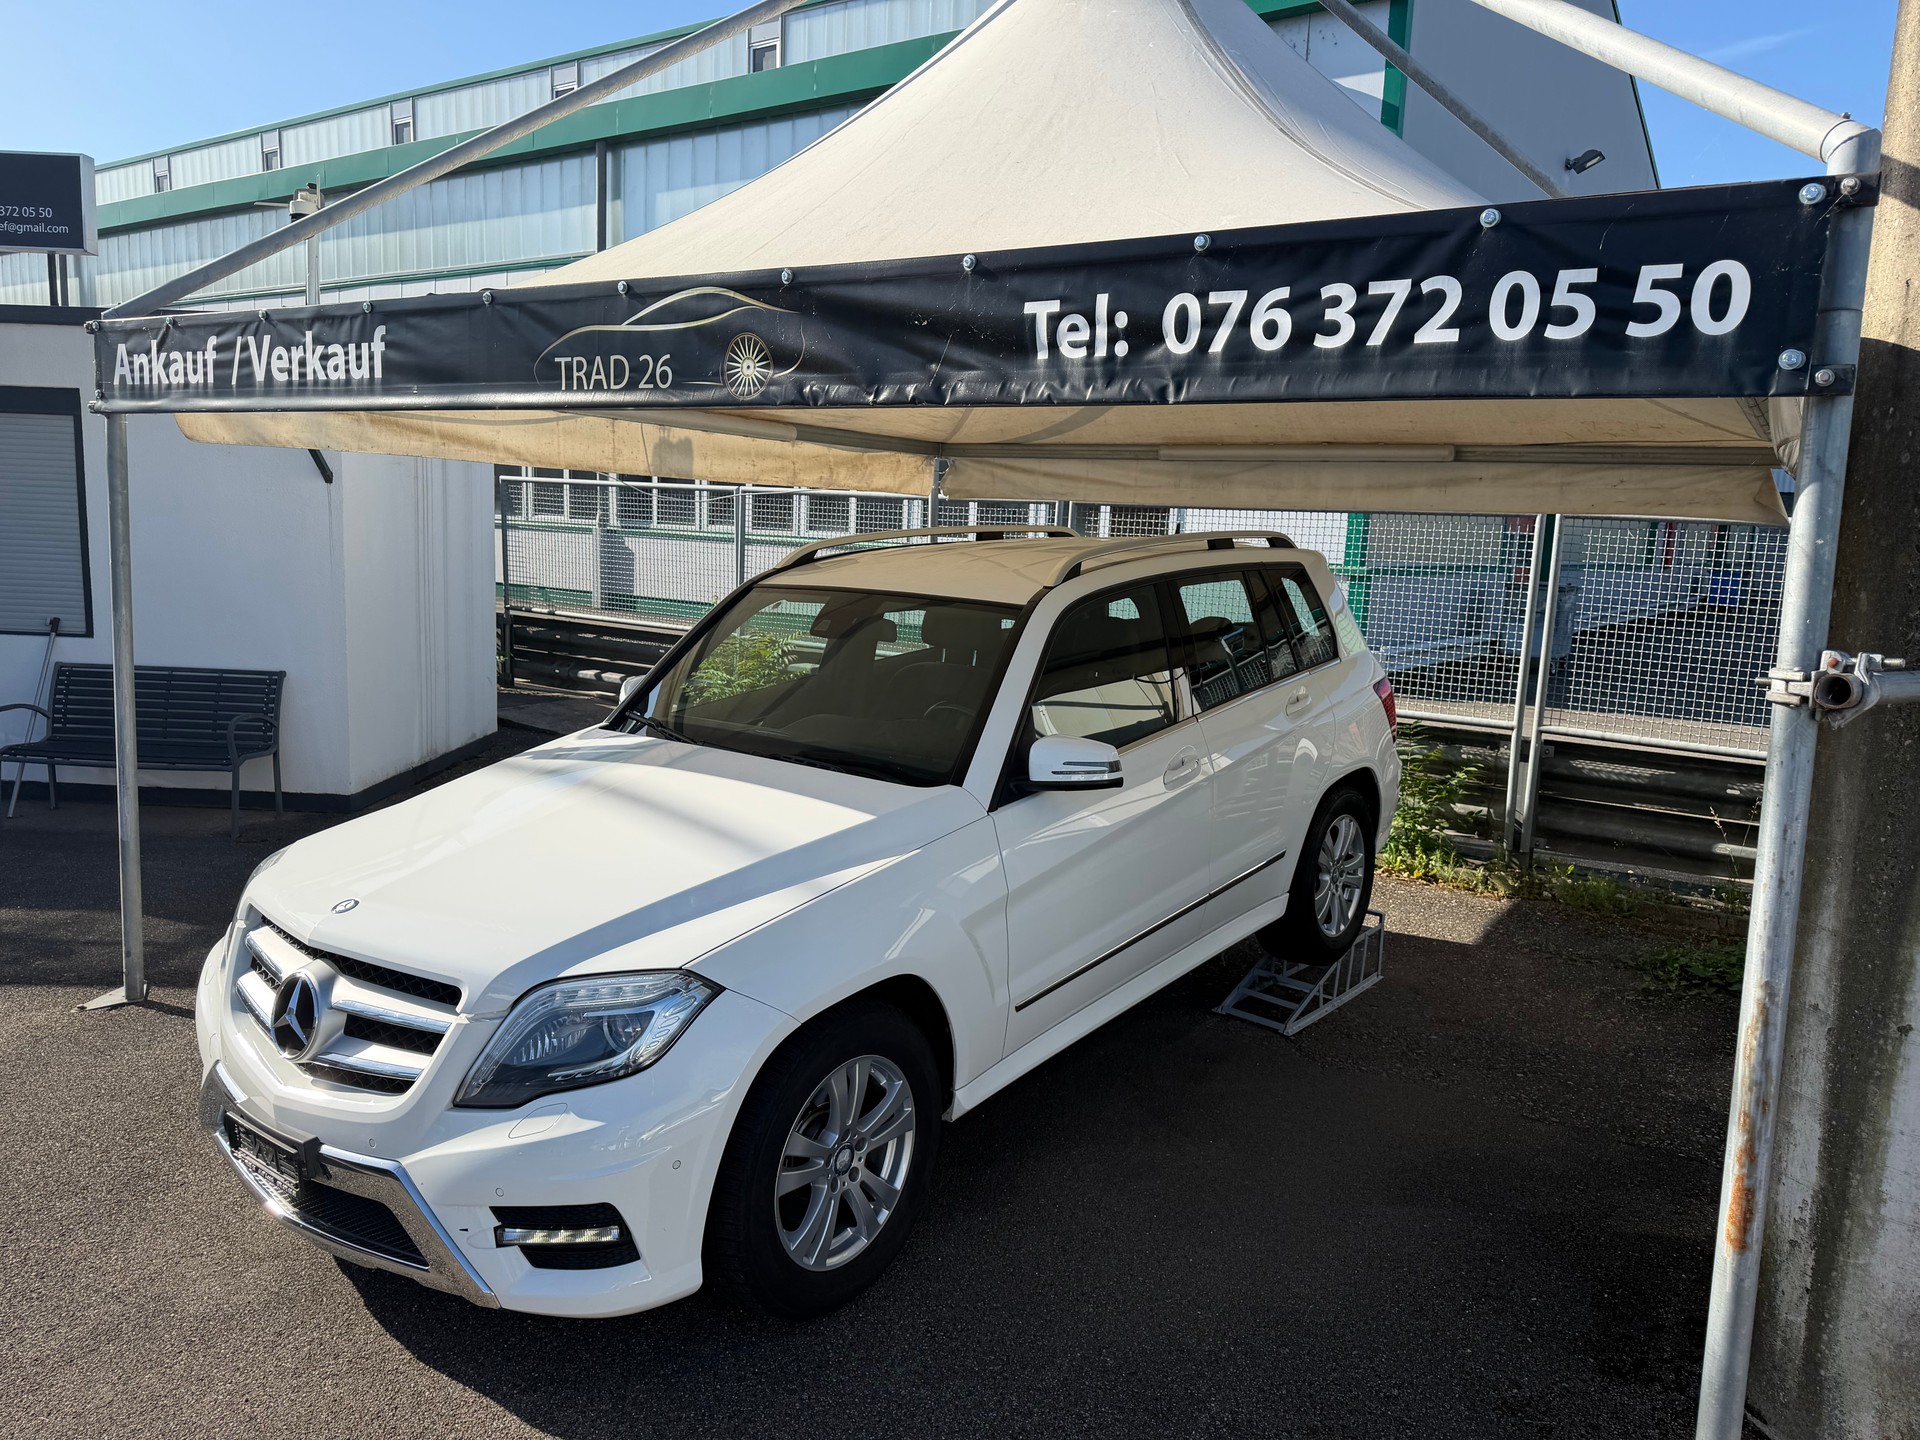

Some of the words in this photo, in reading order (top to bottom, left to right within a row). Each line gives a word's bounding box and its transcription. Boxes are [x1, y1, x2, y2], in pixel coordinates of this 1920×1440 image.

[22, 206, 36, 218] 05
[38, 207, 53, 218] 50
[1023, 293, 1129, 360] Tel:
[1161, 286, 1292, 355] 076
[1313, 275, 1463, 348] 372
[1488, 267, 1598, 341] 05
[1624, 259, 1752, 337] 50
[113, 335, 217, 385] Ankauf
[554, 354, 630, 391] TRAD
[638, 353, 673, 389] 26
